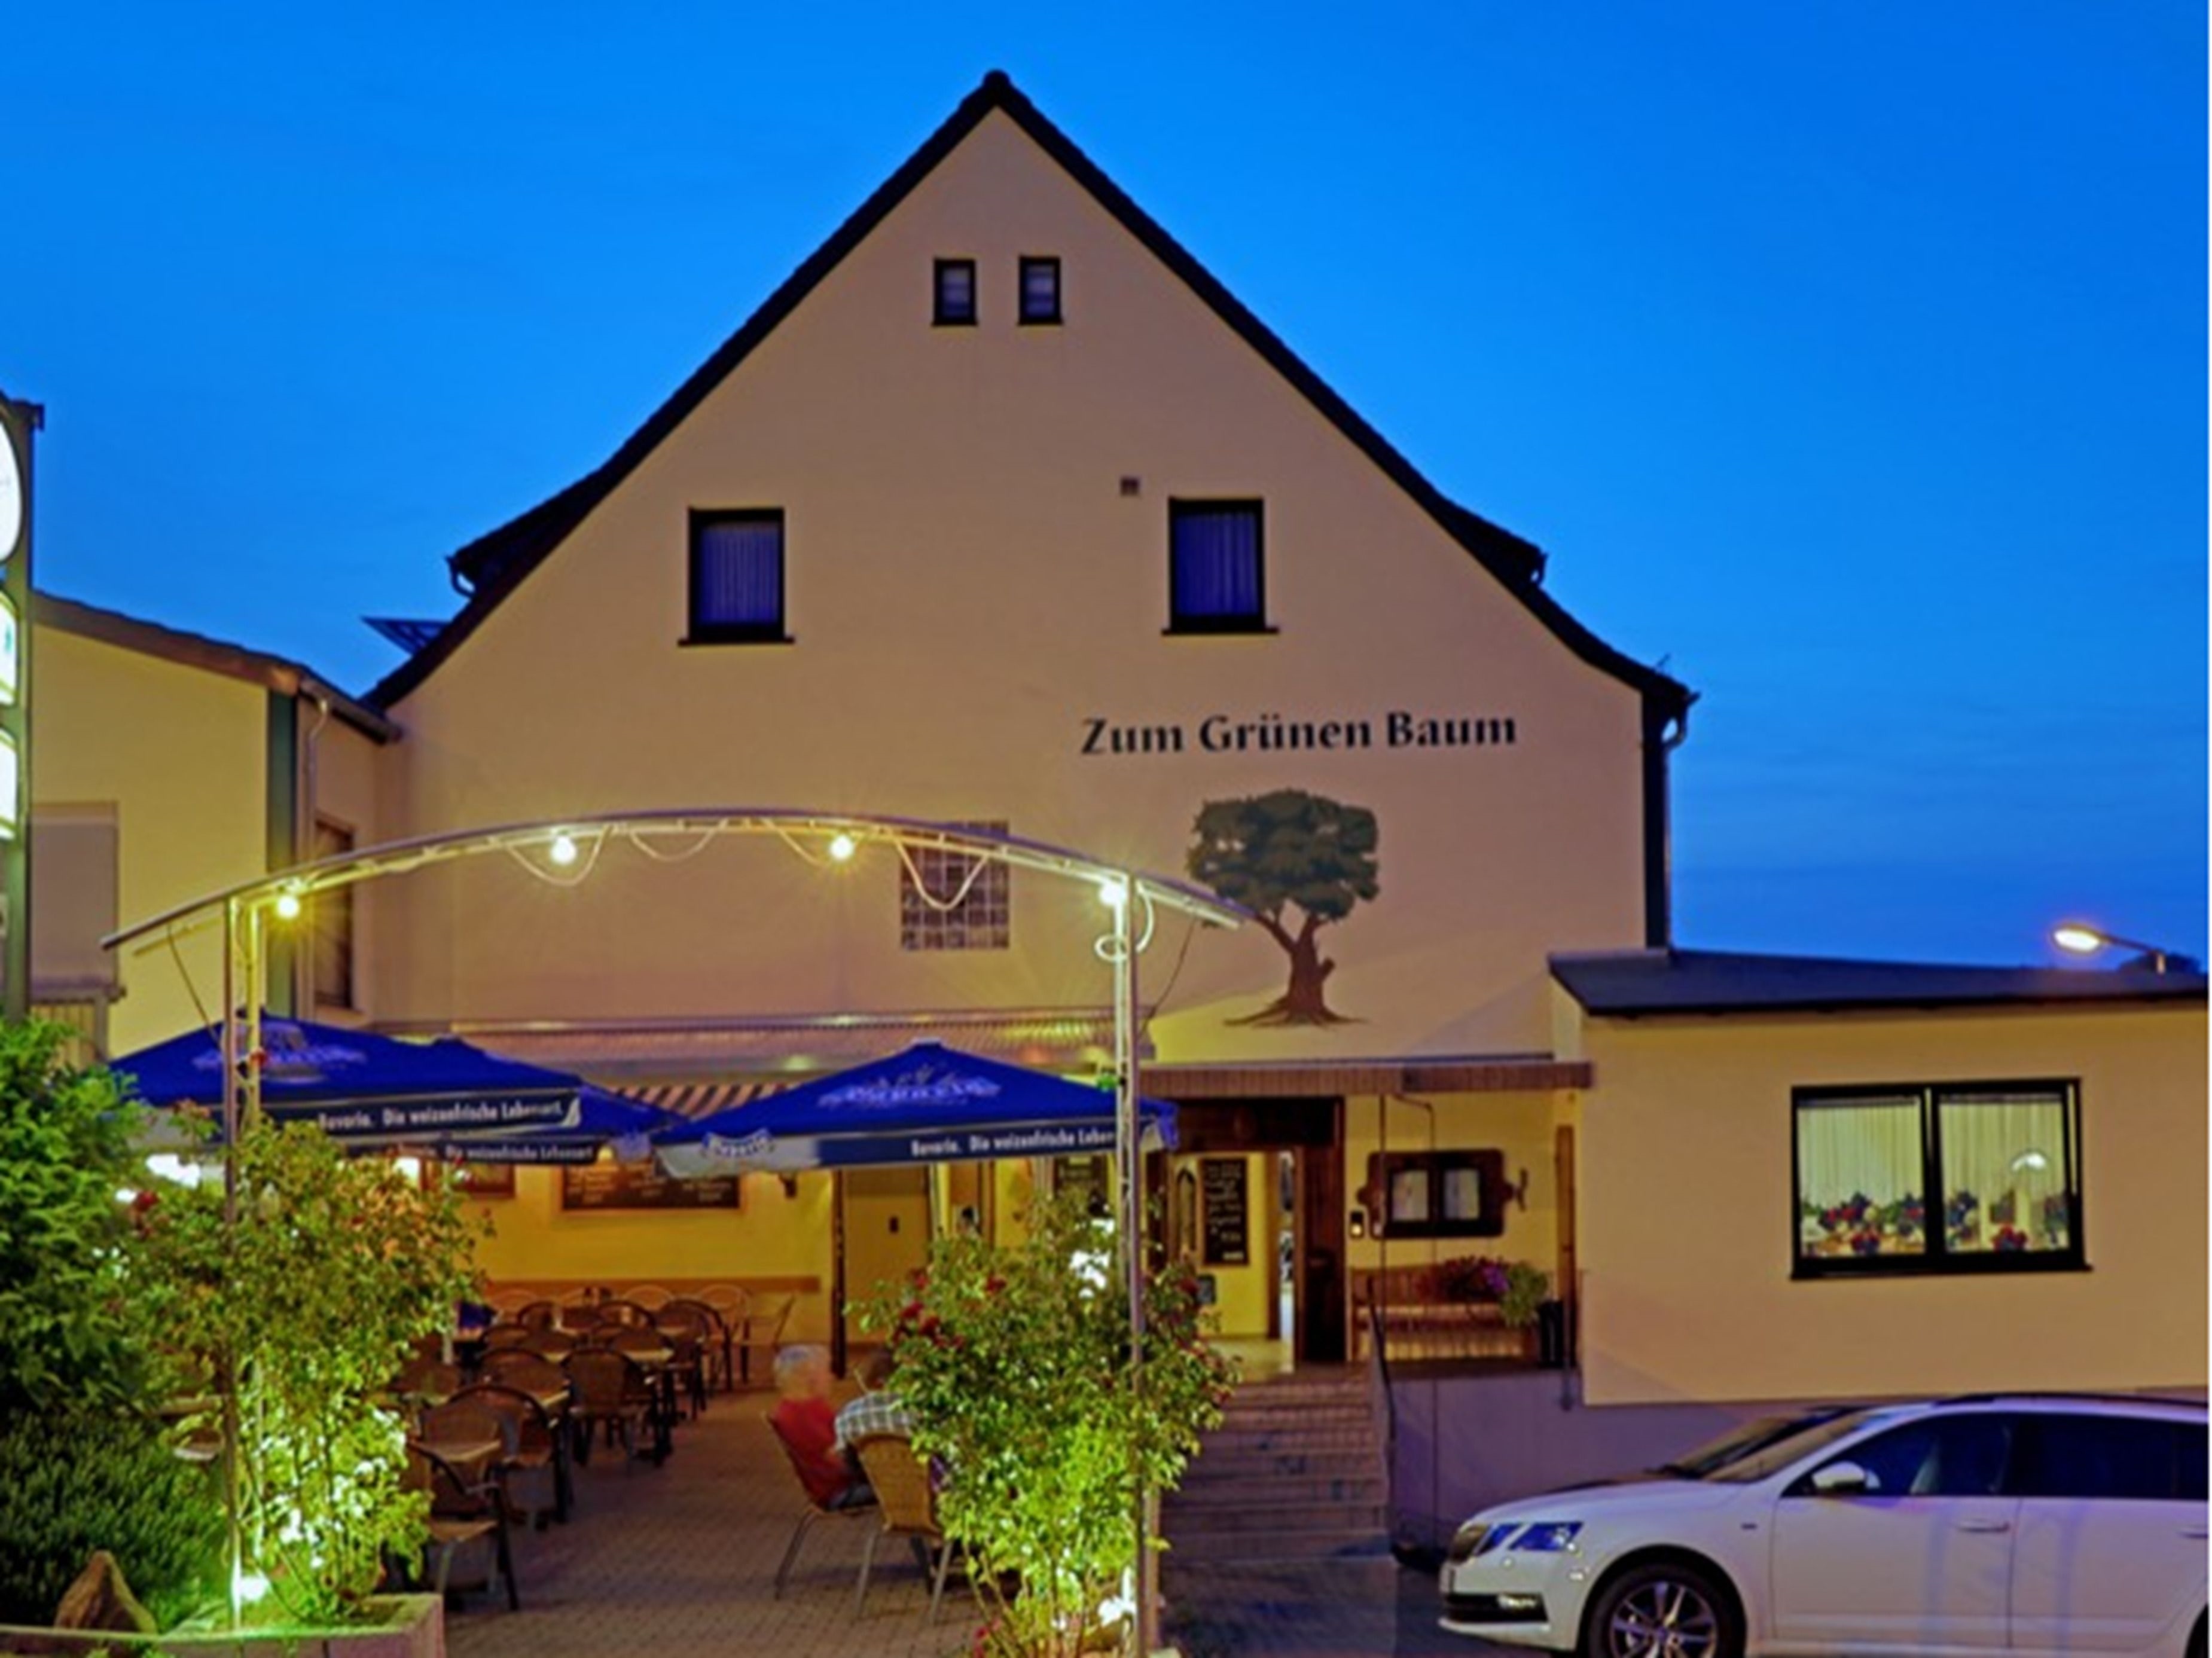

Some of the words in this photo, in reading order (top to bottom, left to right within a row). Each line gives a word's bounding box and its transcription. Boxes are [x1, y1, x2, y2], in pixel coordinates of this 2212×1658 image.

[1081, 718, 1183, 755] Zum
[1200, 715, 1371, 752] Grünen
[1387, 711, 1517, 748] Baum
[382, 1108, 405, 1126] Die
[410, 1101, 498, 1124] weizenfrische
[969, 1134, 990, 1152] Die
[993, 1127, 1075, 1150] weizenfrische
[1078, 1126, 1115, 1145] Leben
